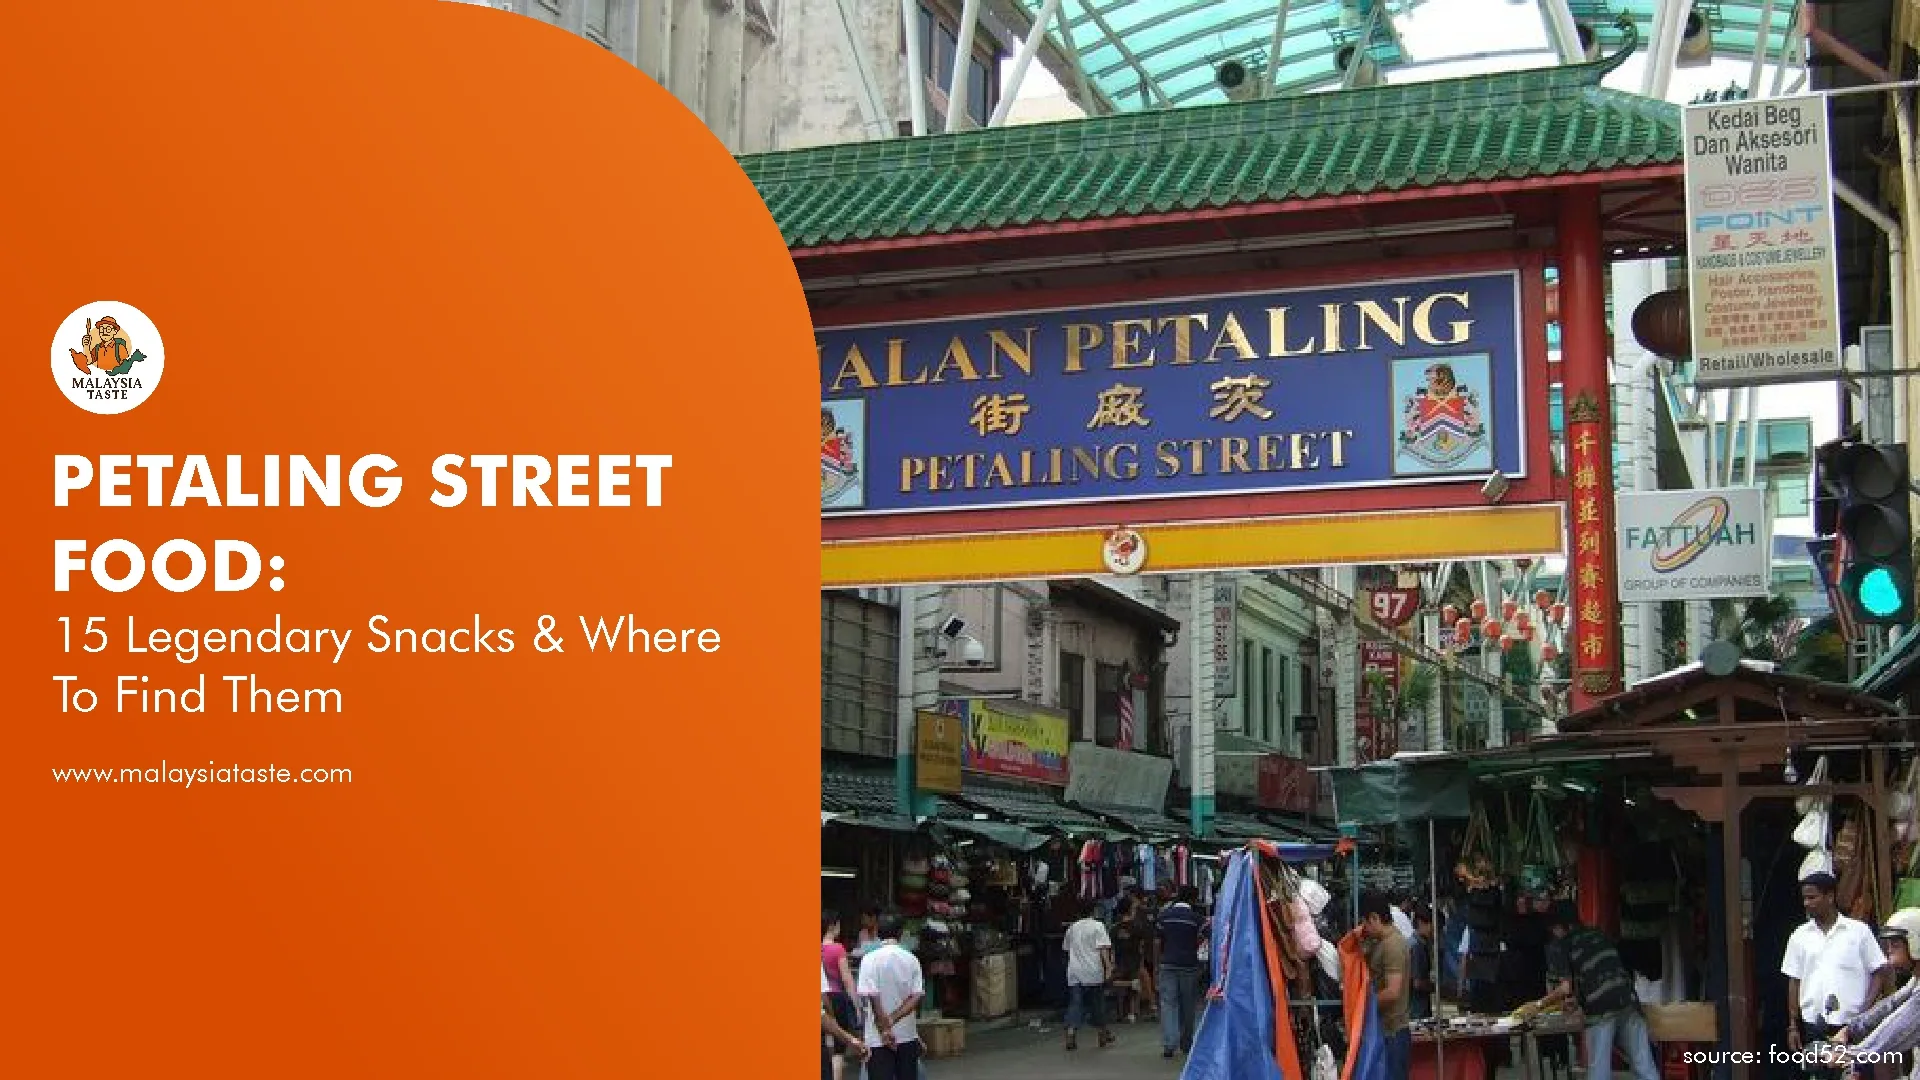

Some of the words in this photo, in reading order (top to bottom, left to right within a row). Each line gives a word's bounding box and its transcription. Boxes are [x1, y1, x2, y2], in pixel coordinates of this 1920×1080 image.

[1708, 107, 1759, 131] Kedai
[1765, 105, 1801, 128] Beg
[1694, 136, 1729, 156] Dan
[1736, 123, 1818, 152] Aksesori
[1726, 154, 1788, 176] Wanita
[1708, 273, 1733, 287] Hair
[817, 325, 1039, 392] ALAN
[1062, 291, 1475, 373] PETALING
[1700, 348, 1834, 371] Retail/Wholesale
[900, 442, 1140, 493] PETALING
[1156, 429, 1353, 478] STREET
[1625, 522, 1756, 550] FATTUAH
[1624, 577, 1667, 591] GROUP
[1670, 577, 1687, 589] OF
[1690, 574, 1761, 589] COMPANIES
[1374, 591, 1408, 619] 97
